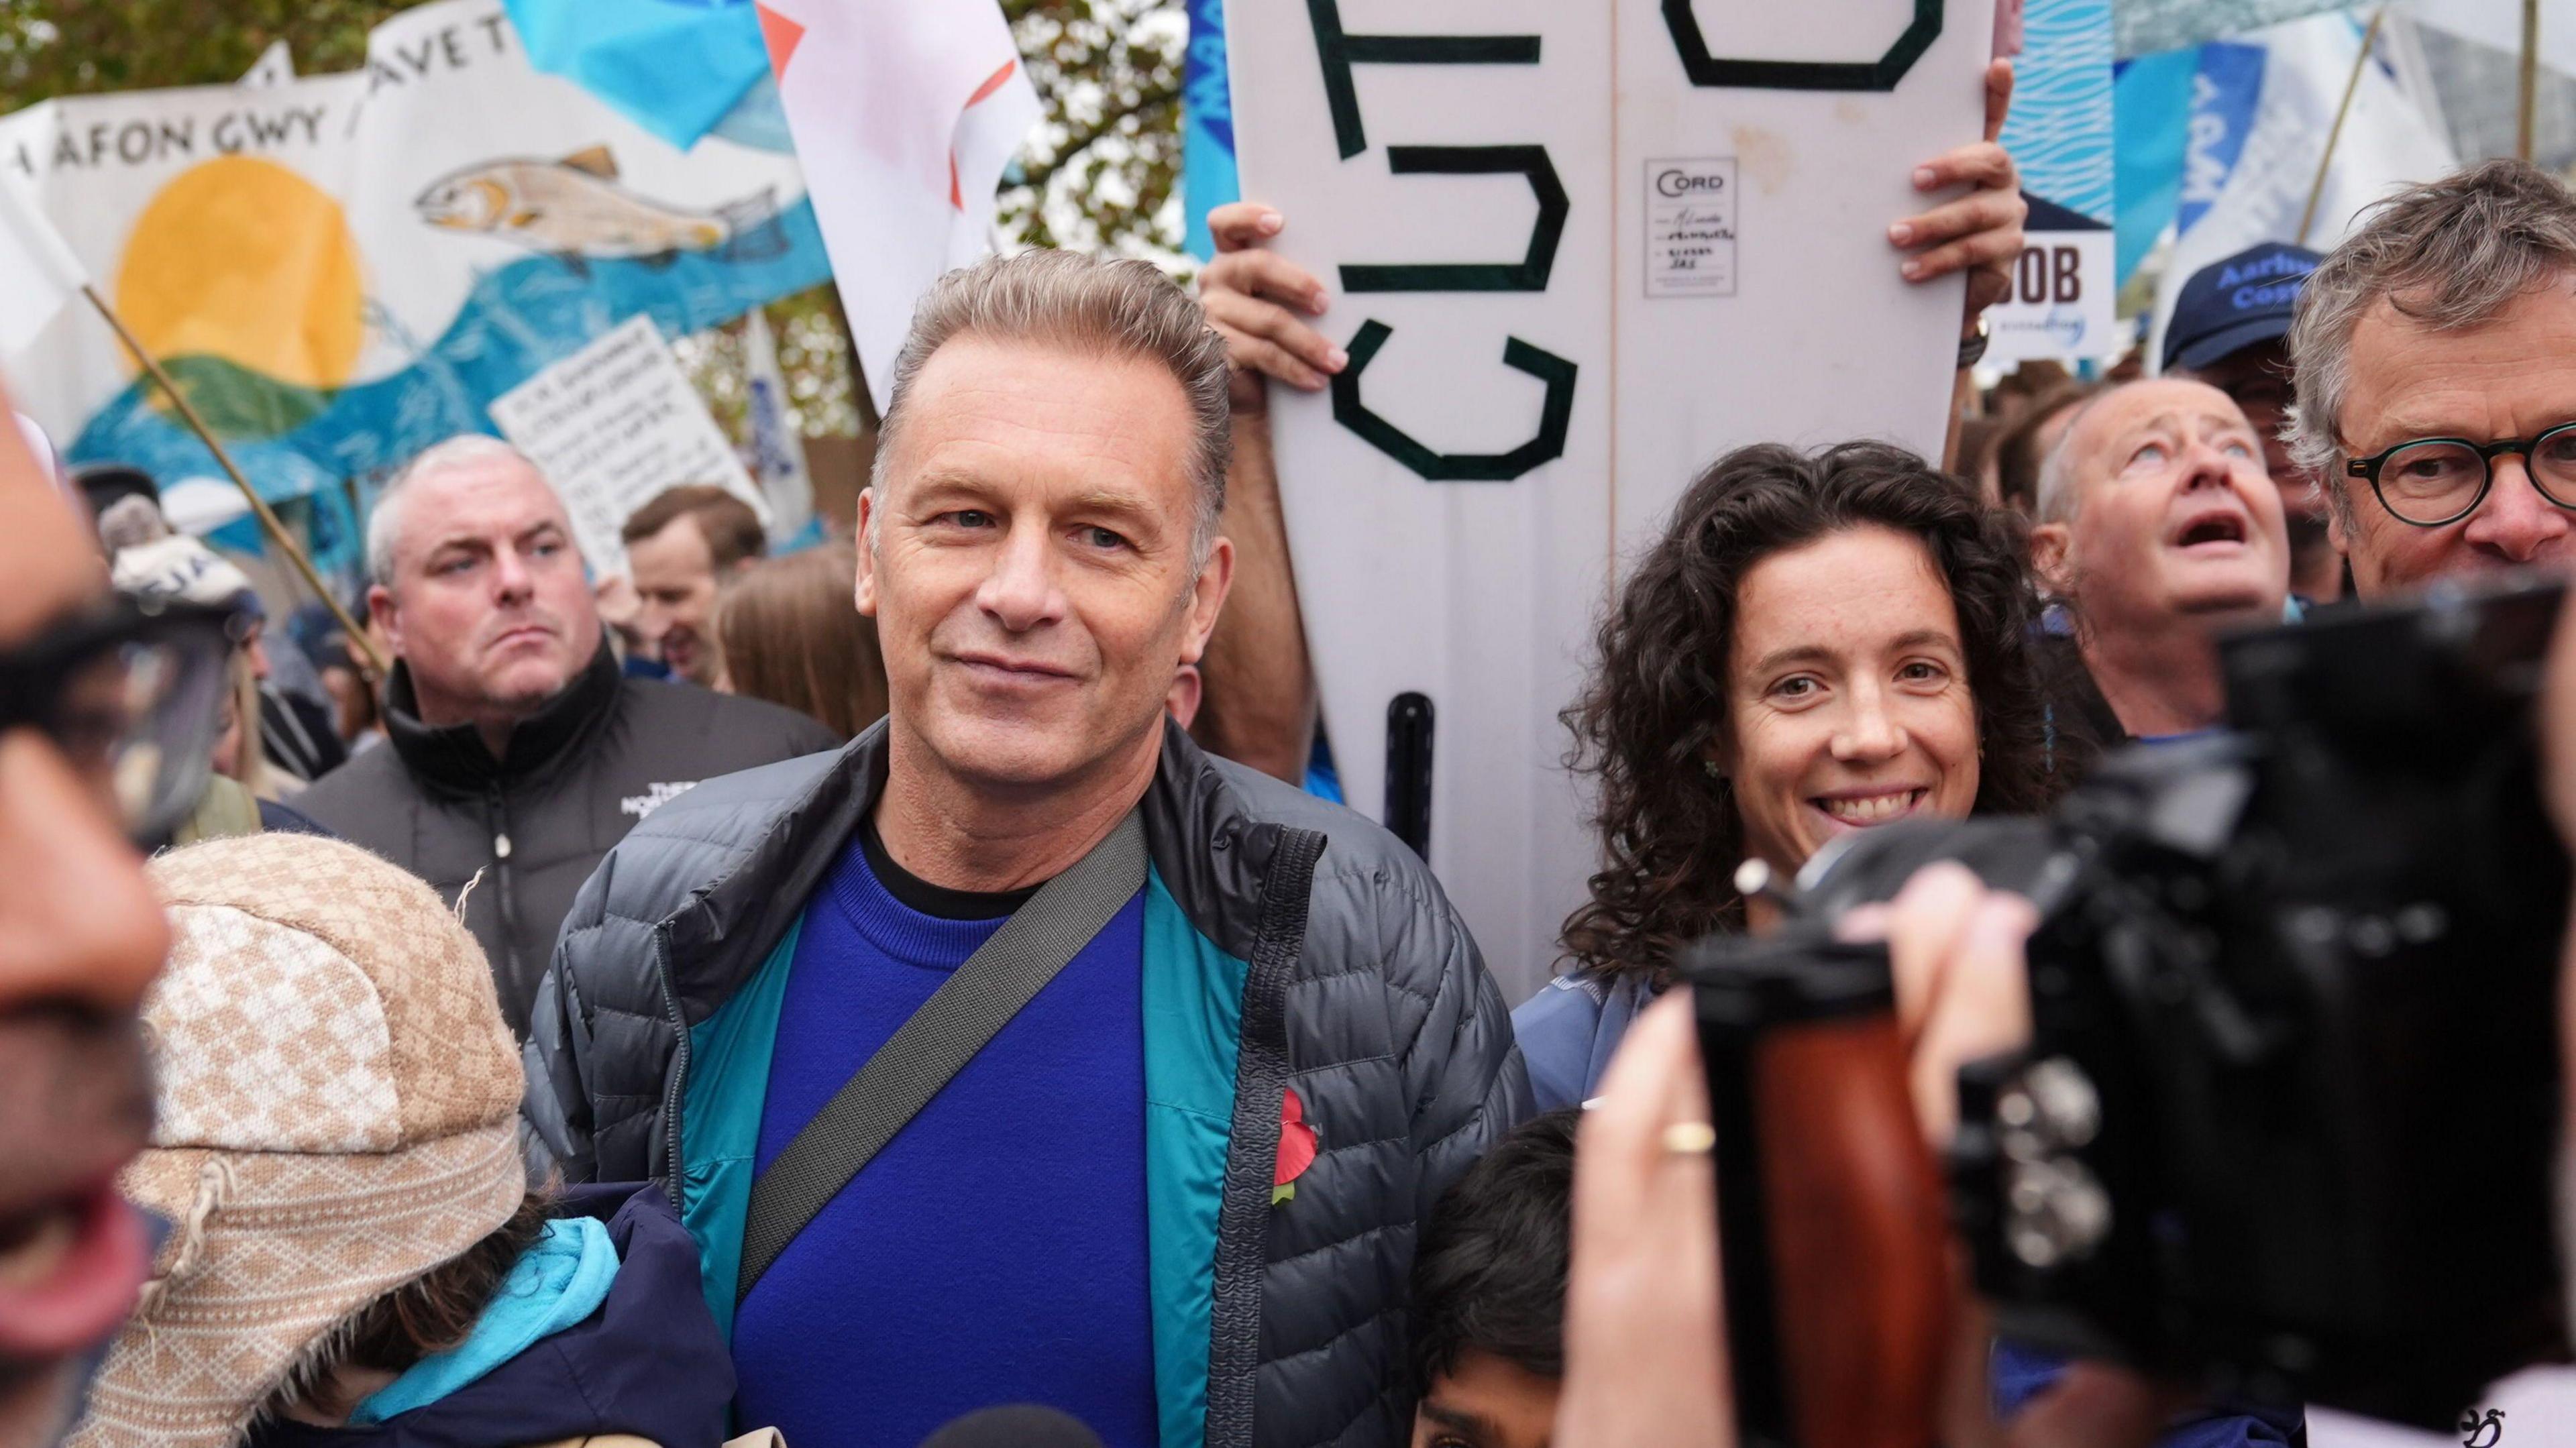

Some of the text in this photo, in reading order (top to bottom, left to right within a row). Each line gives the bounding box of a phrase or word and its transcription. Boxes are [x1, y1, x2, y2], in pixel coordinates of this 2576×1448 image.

[54, 117, 193, 166] AFON
[213, 105, 324, 155] GWY
[1657, 169, 1723, 198] CORD
[1306, 0, 1578, 482] CUT
[1995, 247, 2081, 304] OB
